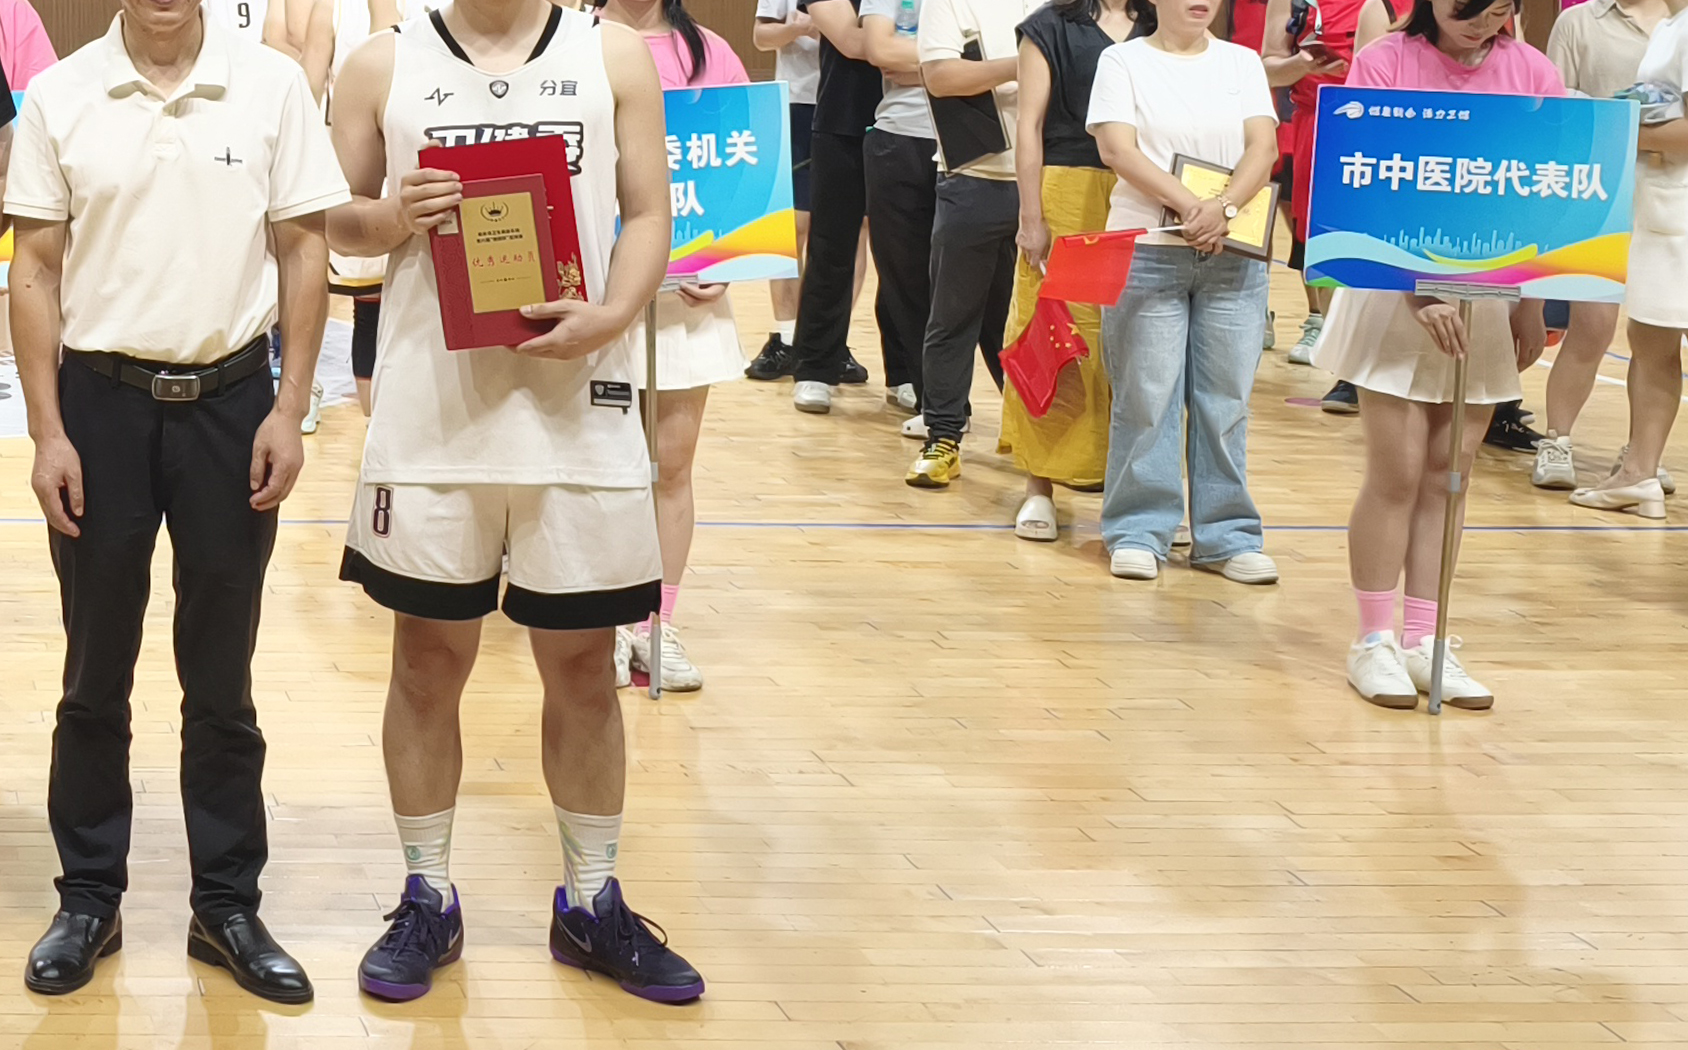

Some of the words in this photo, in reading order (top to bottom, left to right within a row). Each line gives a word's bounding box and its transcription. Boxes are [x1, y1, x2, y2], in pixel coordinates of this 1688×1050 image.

[237, 2, 251, 28] 9
[1339, 151, 1609, 201] 市中医院代表队
[372, 486, 392, 537] 8
